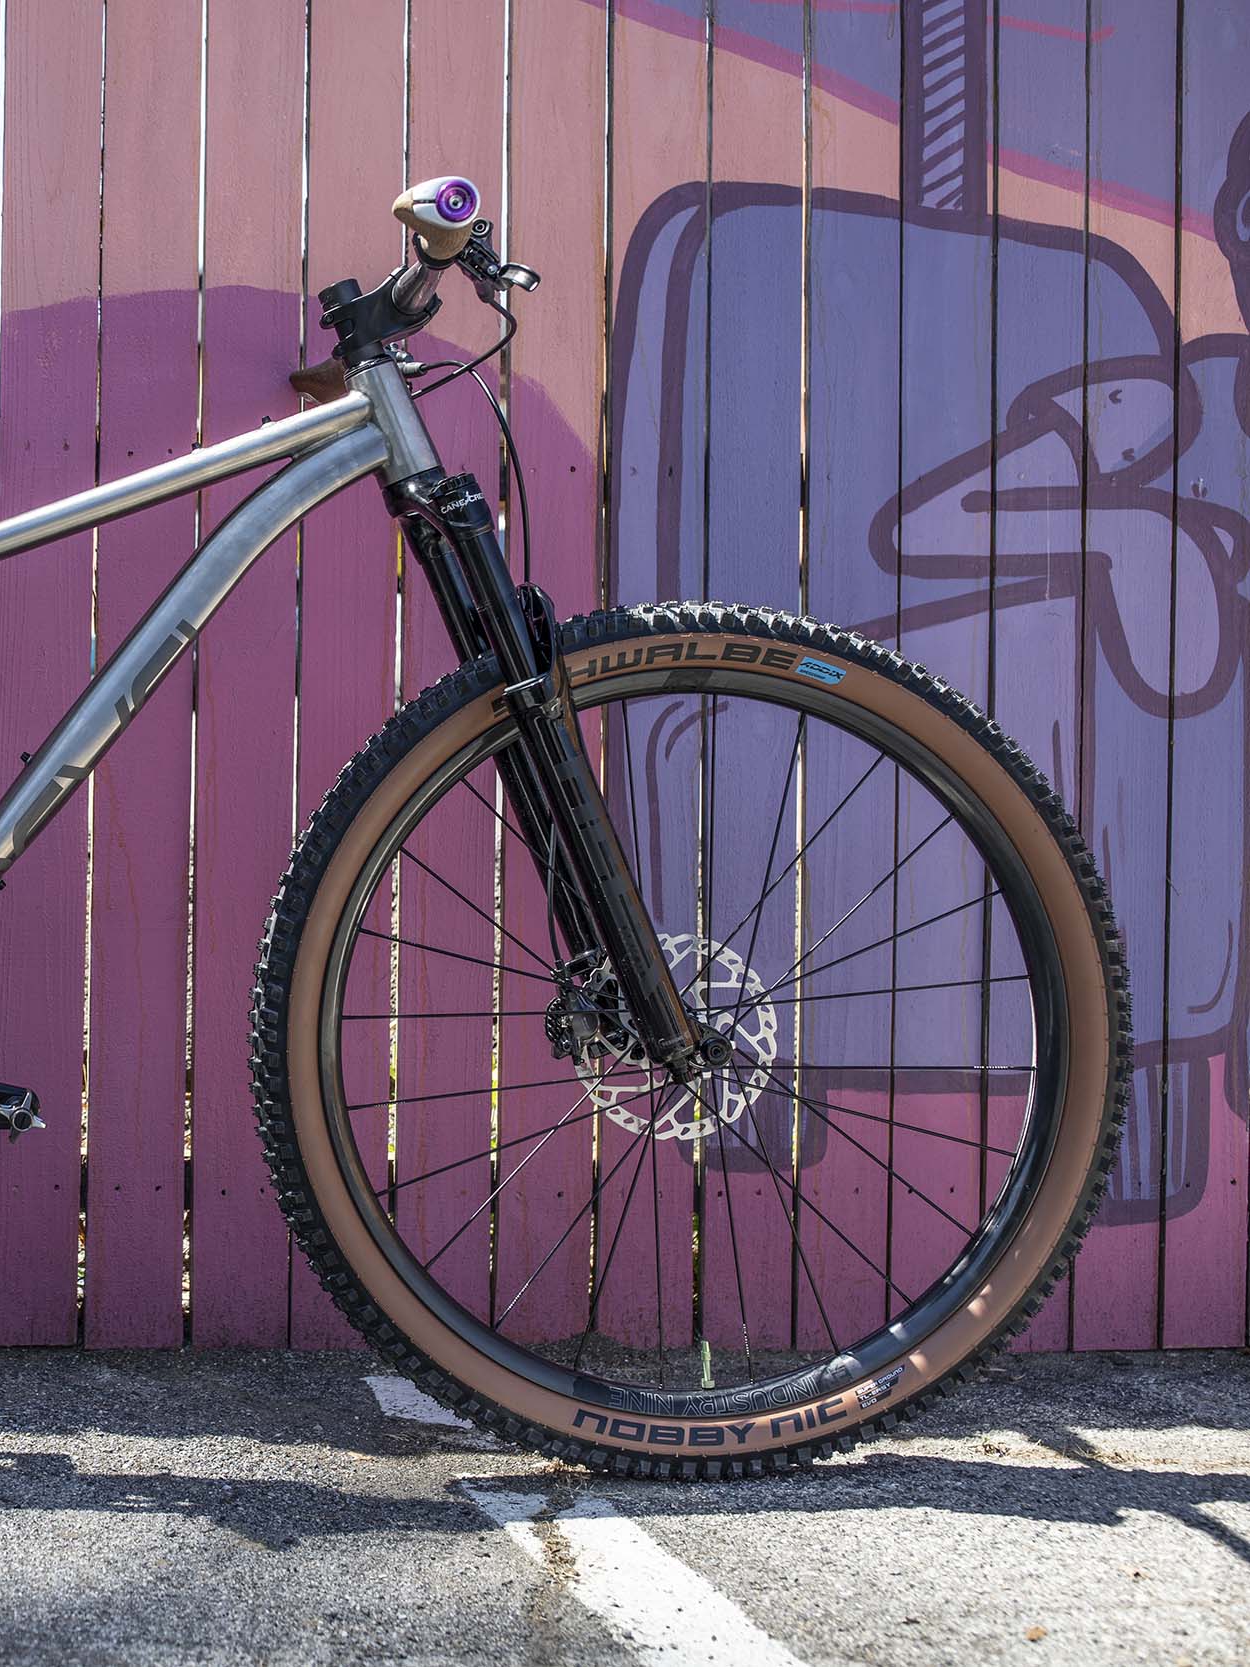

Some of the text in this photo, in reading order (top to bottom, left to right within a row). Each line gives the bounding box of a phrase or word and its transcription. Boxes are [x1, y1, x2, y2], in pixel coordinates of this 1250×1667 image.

[441, 498, 465, 514] CANE
[567, 642, 798, 680] HWALBE
[877, 1367, 903, 1384] GROUND
[608, 1375, 819, 1417] INDUSTRY NINE
[860, 1382, 891, 1401] TL-EASY
[861, 1398, 877, 1408] EVO
[572, 1398, 848, 1447] NOBBY NIC
